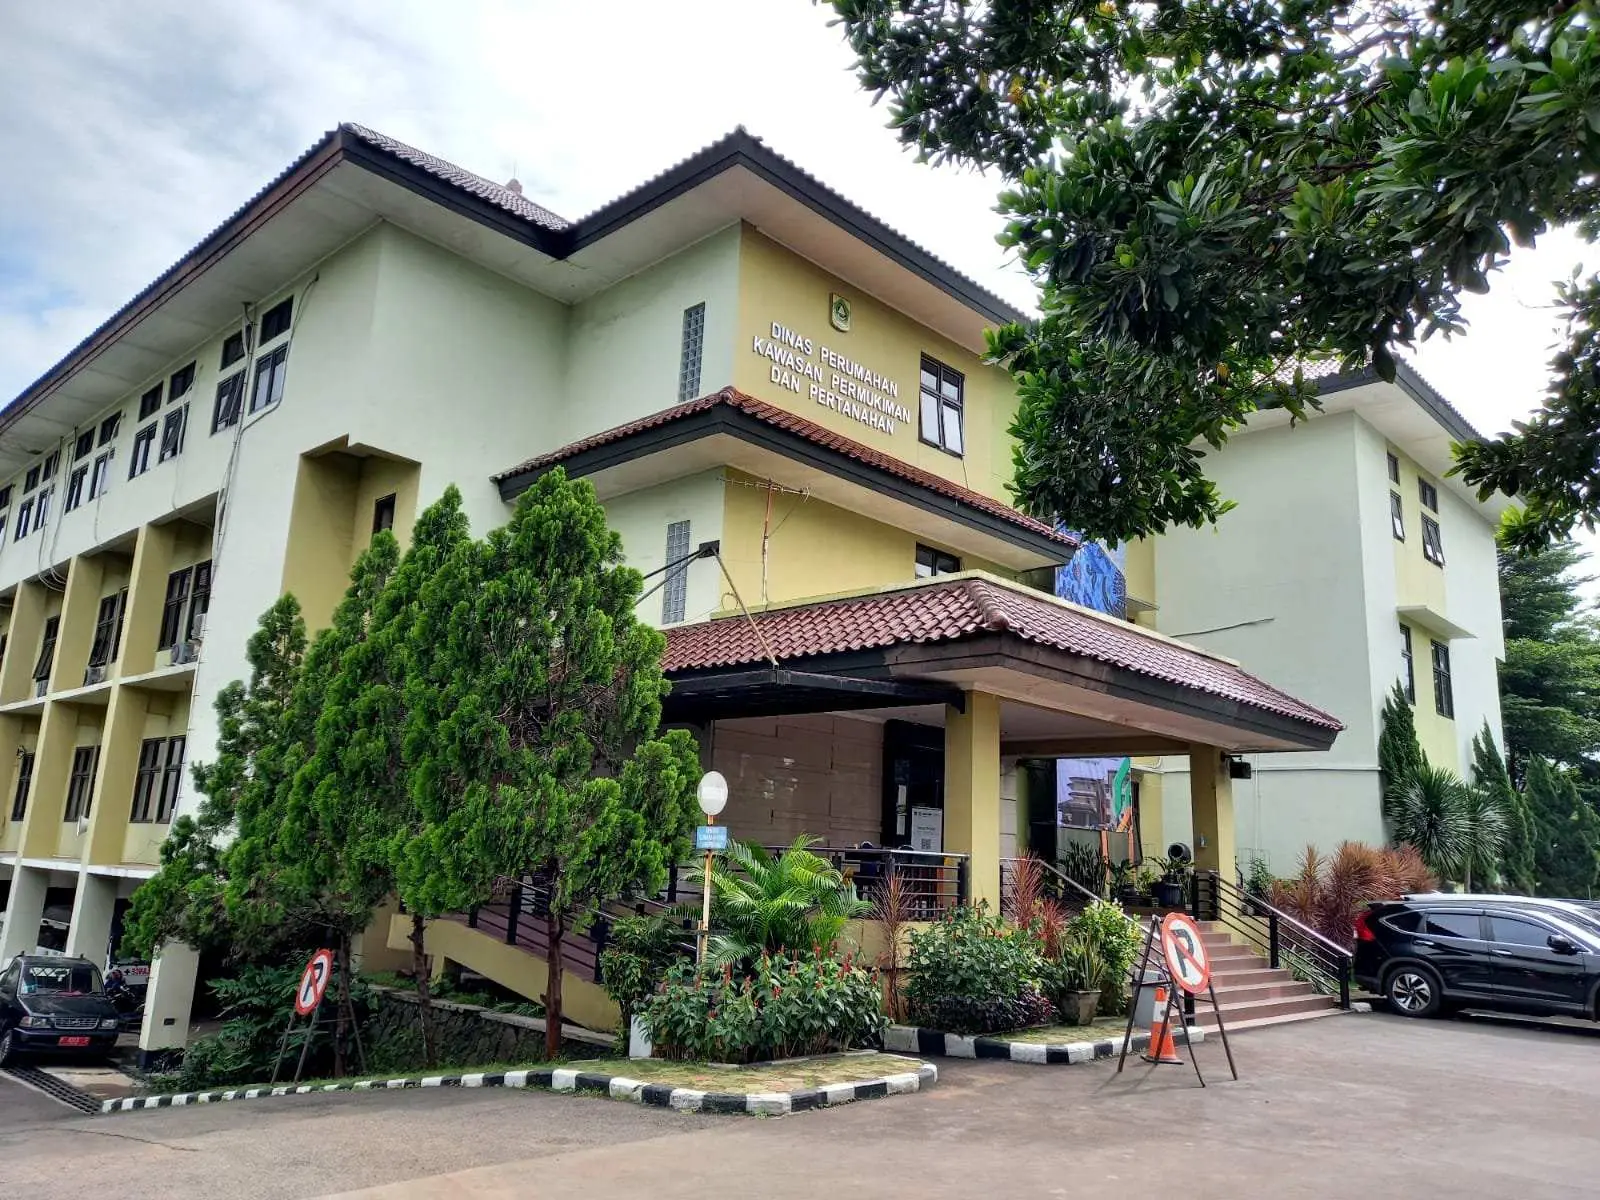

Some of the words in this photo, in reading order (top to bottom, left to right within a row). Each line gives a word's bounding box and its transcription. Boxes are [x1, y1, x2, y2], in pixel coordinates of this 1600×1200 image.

[753, 335, 823, 383] KAWASAN
[831, 373, 910, 424] PERMUKIMAN
[771, 321, 813, 356] DINAS
[820, 346, 898, 398] PERUMAHAN
[770, 366, 800, 393] DAN
[809, 383, 894, 436] PERTANAHAN
[1169, 928, 1195, 978] P
